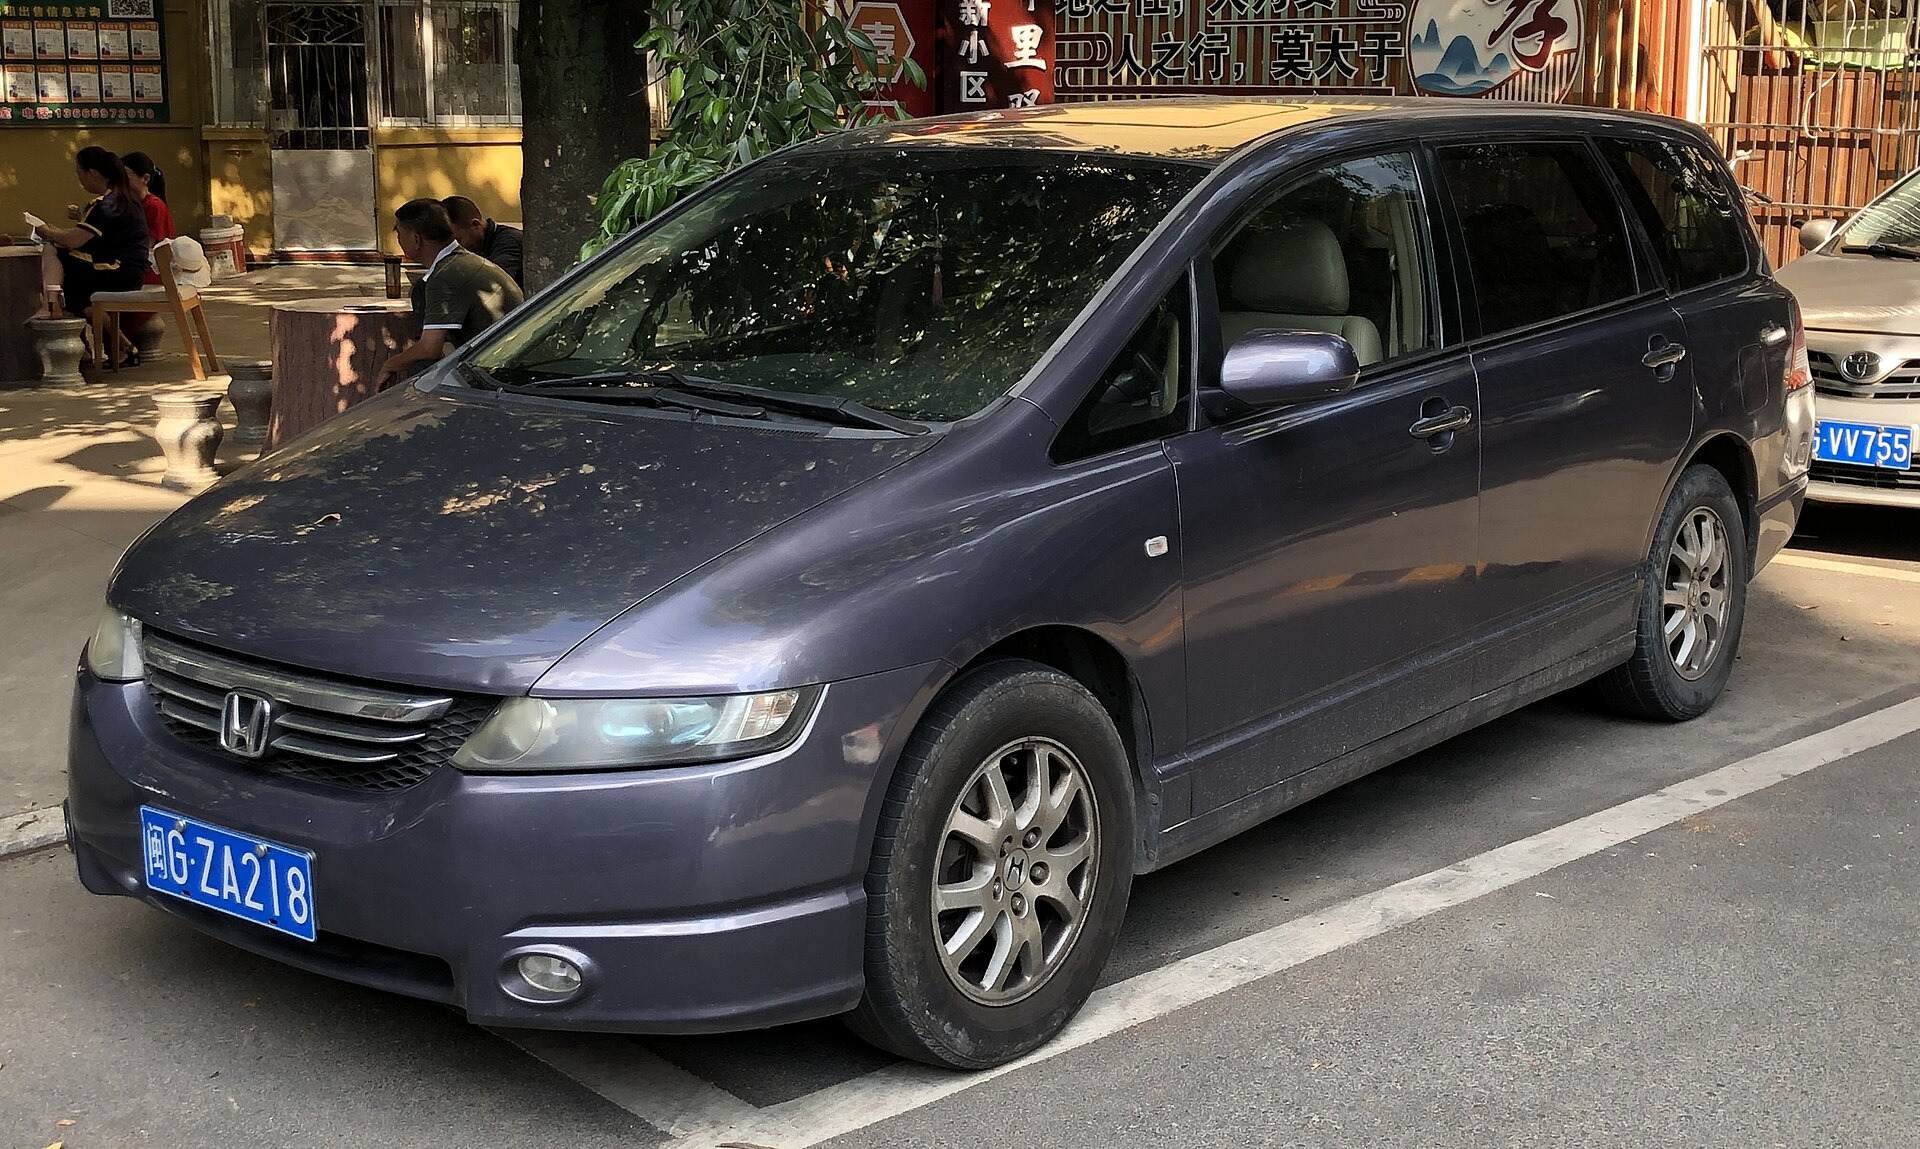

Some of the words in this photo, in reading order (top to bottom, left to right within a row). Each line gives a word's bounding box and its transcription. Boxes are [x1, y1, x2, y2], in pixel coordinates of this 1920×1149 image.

[0, 5, 101, 18] 租出售信息咨询
[959, 0, 991, 103] 新小区
[1108, 28, 1405, 82] 人之行，莫大于
